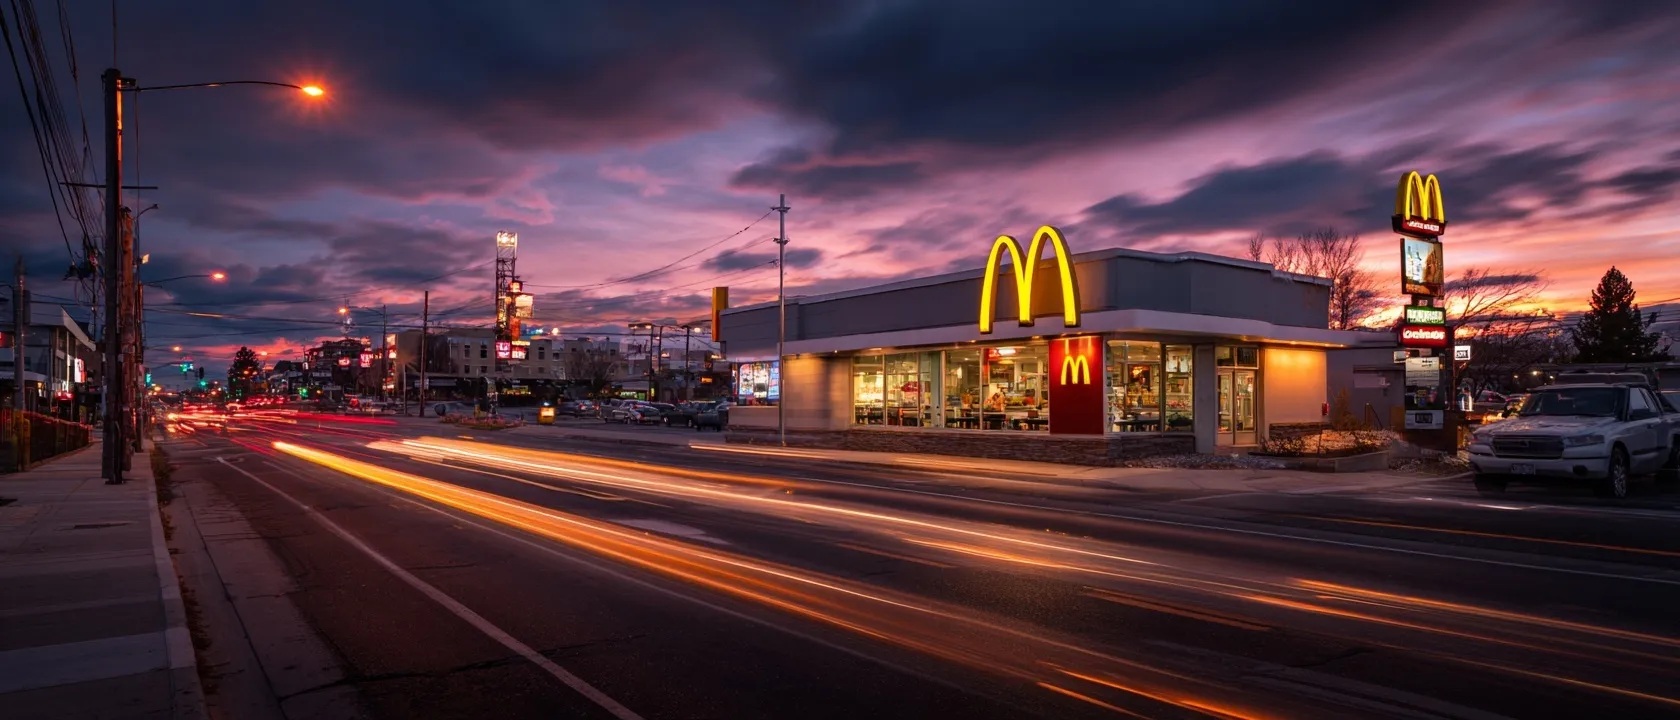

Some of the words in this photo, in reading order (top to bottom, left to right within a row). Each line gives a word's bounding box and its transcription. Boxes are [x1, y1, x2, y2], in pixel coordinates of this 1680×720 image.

[1405, 171, 1444, 224] M
[979, 225, 1078, 334] M
[1060, 355, 1091, 385] M
